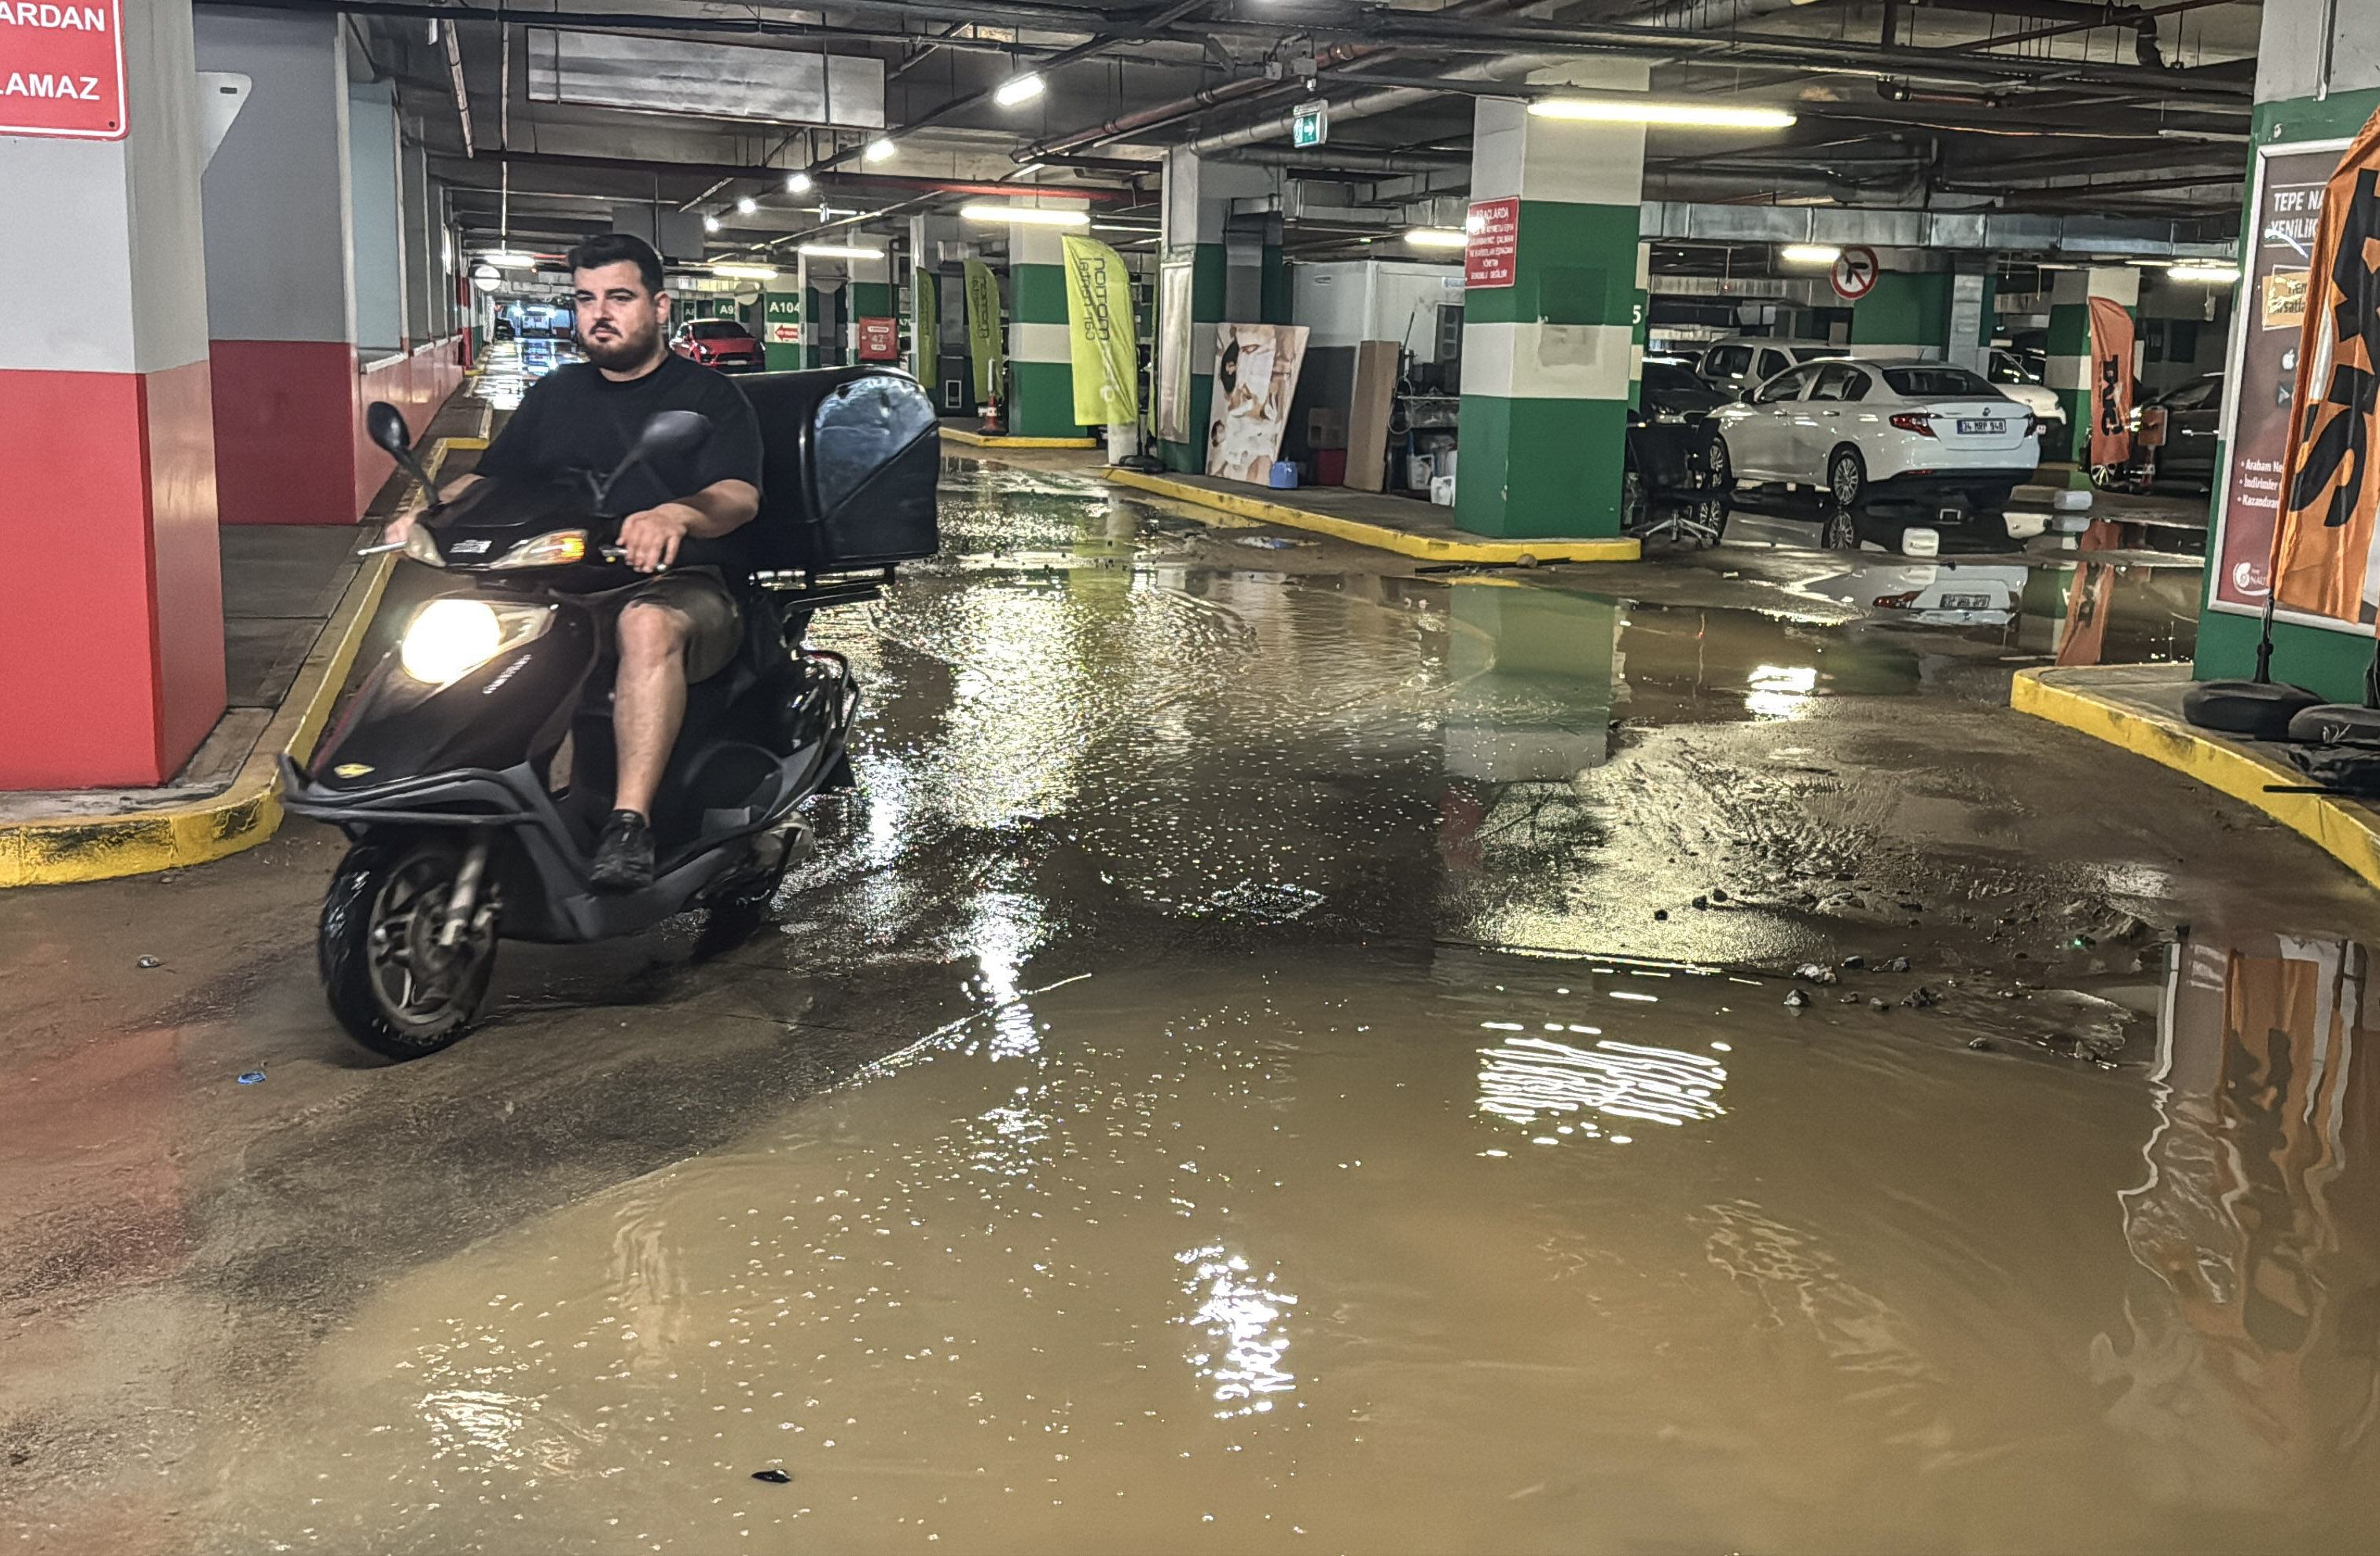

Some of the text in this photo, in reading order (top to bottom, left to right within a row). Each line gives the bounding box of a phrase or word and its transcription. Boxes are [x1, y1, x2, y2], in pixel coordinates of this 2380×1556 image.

[0, 72, 100, 101] AMAZ
[2275, 191, 2305, 212] TEPE
[720, 305, 736, 314] A9
[769, 302, 799, 314] A104
[1633, 305, 1641, 324] 5
